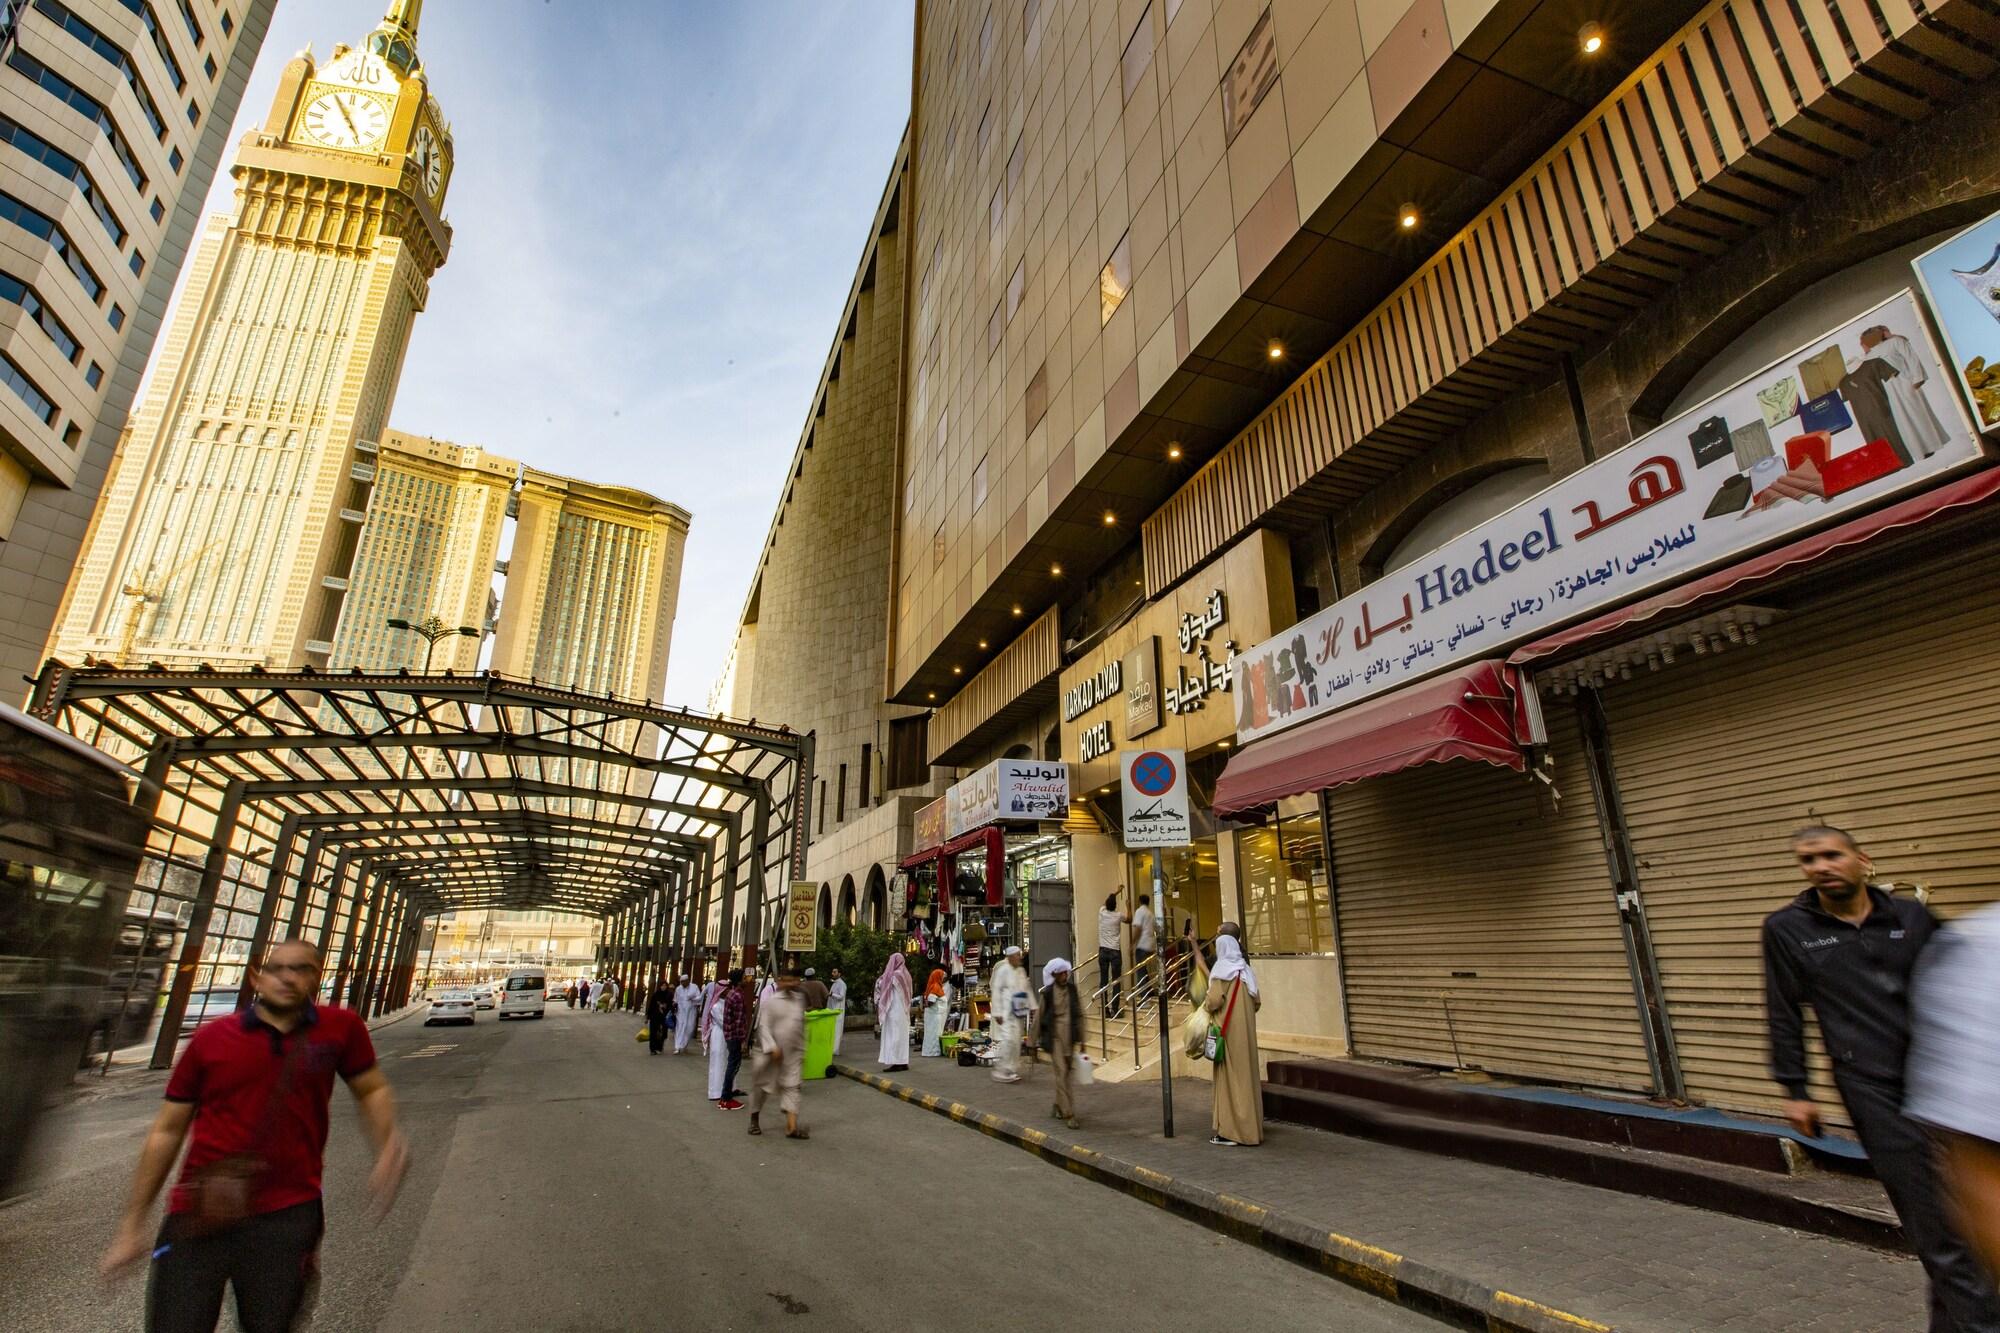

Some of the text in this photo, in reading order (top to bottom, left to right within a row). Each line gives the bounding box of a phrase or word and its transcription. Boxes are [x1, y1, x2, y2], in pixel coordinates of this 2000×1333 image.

[1415, 508, 1562, 614] Hadeel
[1626, 523, 1696, 575] للملابس
[1178, 588, 1224, 653] فندق
[1447, 615, 1484, 651] نسائي
[1402, 639, 1435, 670] بناتي
[1325, 669, 1354, 698] أطفال
[1363, 657, 1391, 685] ولادي
[1064, 660, 1121, 723] MARKAD AJYAD
[1080, 720, 1111, 762] HOTEL
[1010, 767, 1065, 781] الوليد
[1011, 782, 1066, 793] Alwalid
[1127, 824, 1186, 835] ممنوع الوقوف
[1800, 935, 1840, 950] Reebok
